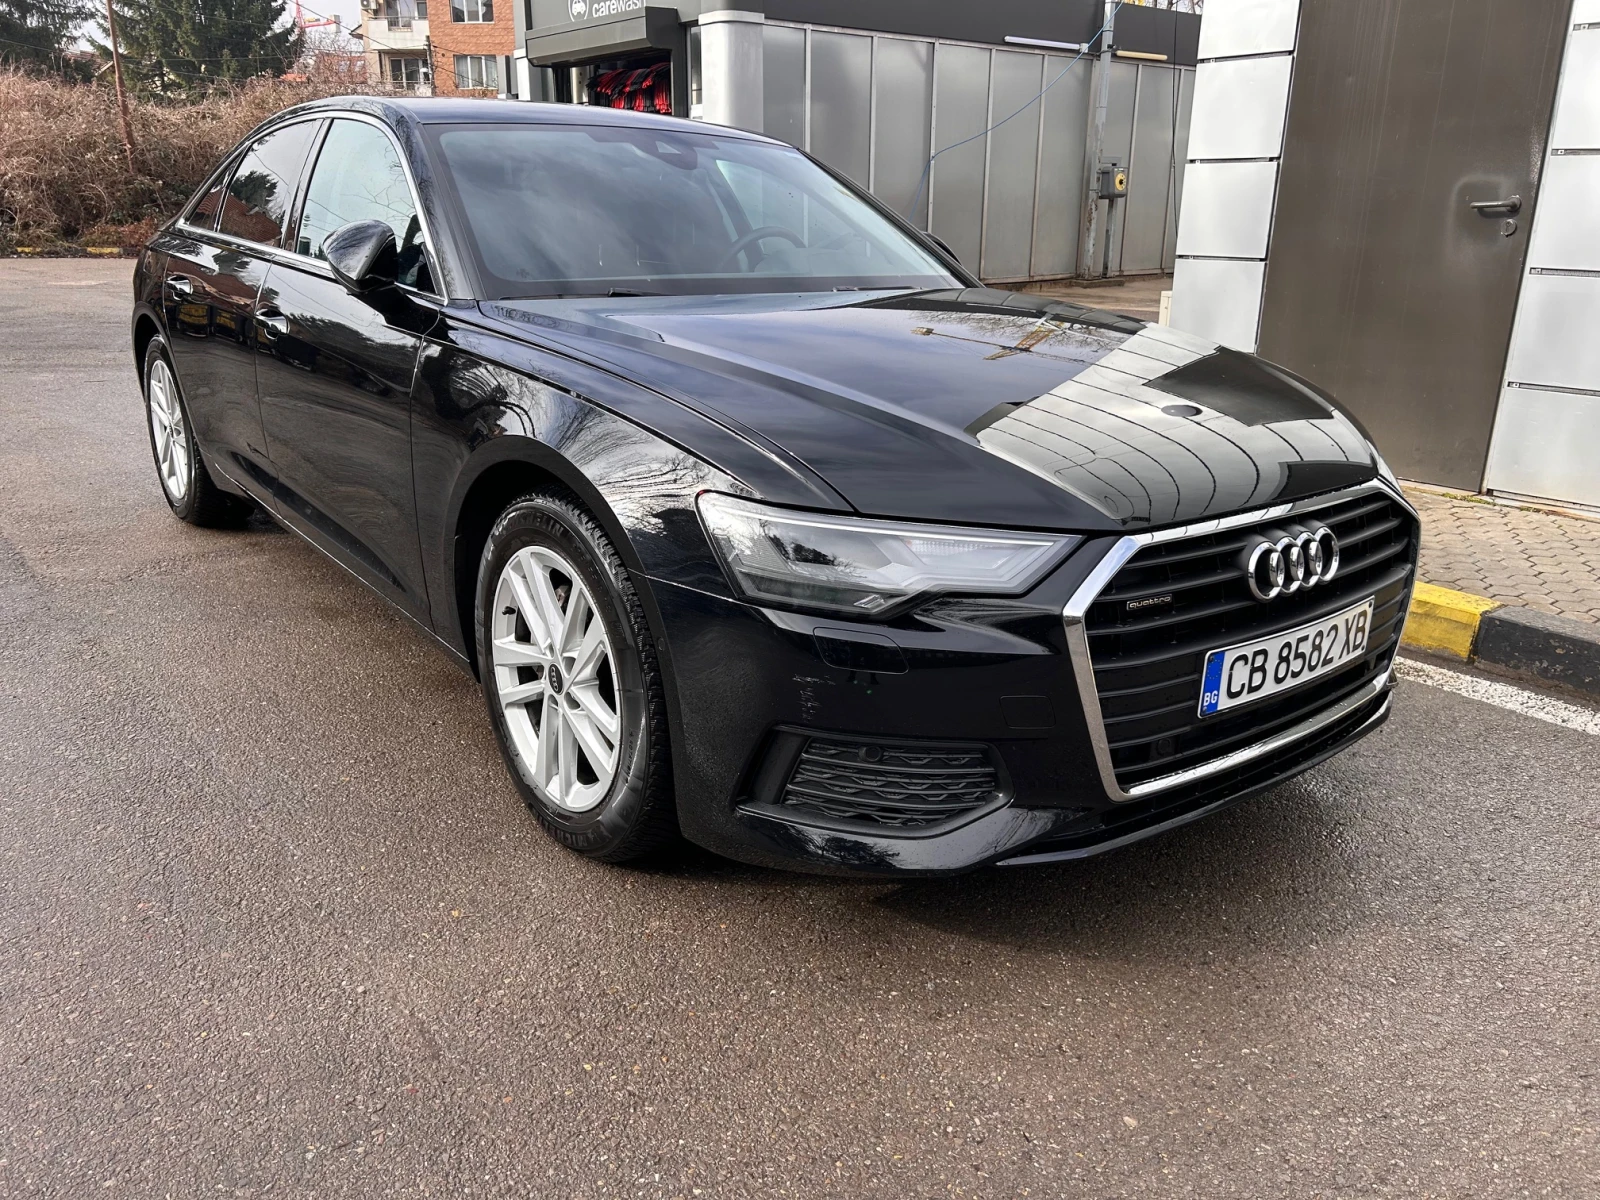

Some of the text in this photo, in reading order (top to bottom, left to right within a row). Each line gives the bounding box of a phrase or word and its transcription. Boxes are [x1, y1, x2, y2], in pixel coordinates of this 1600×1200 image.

[1129, 596, 1171, 608] quattro
[1226, 609, 1368, 699] CB 8582 XB
[1203, 692, 1218, 706] BG
